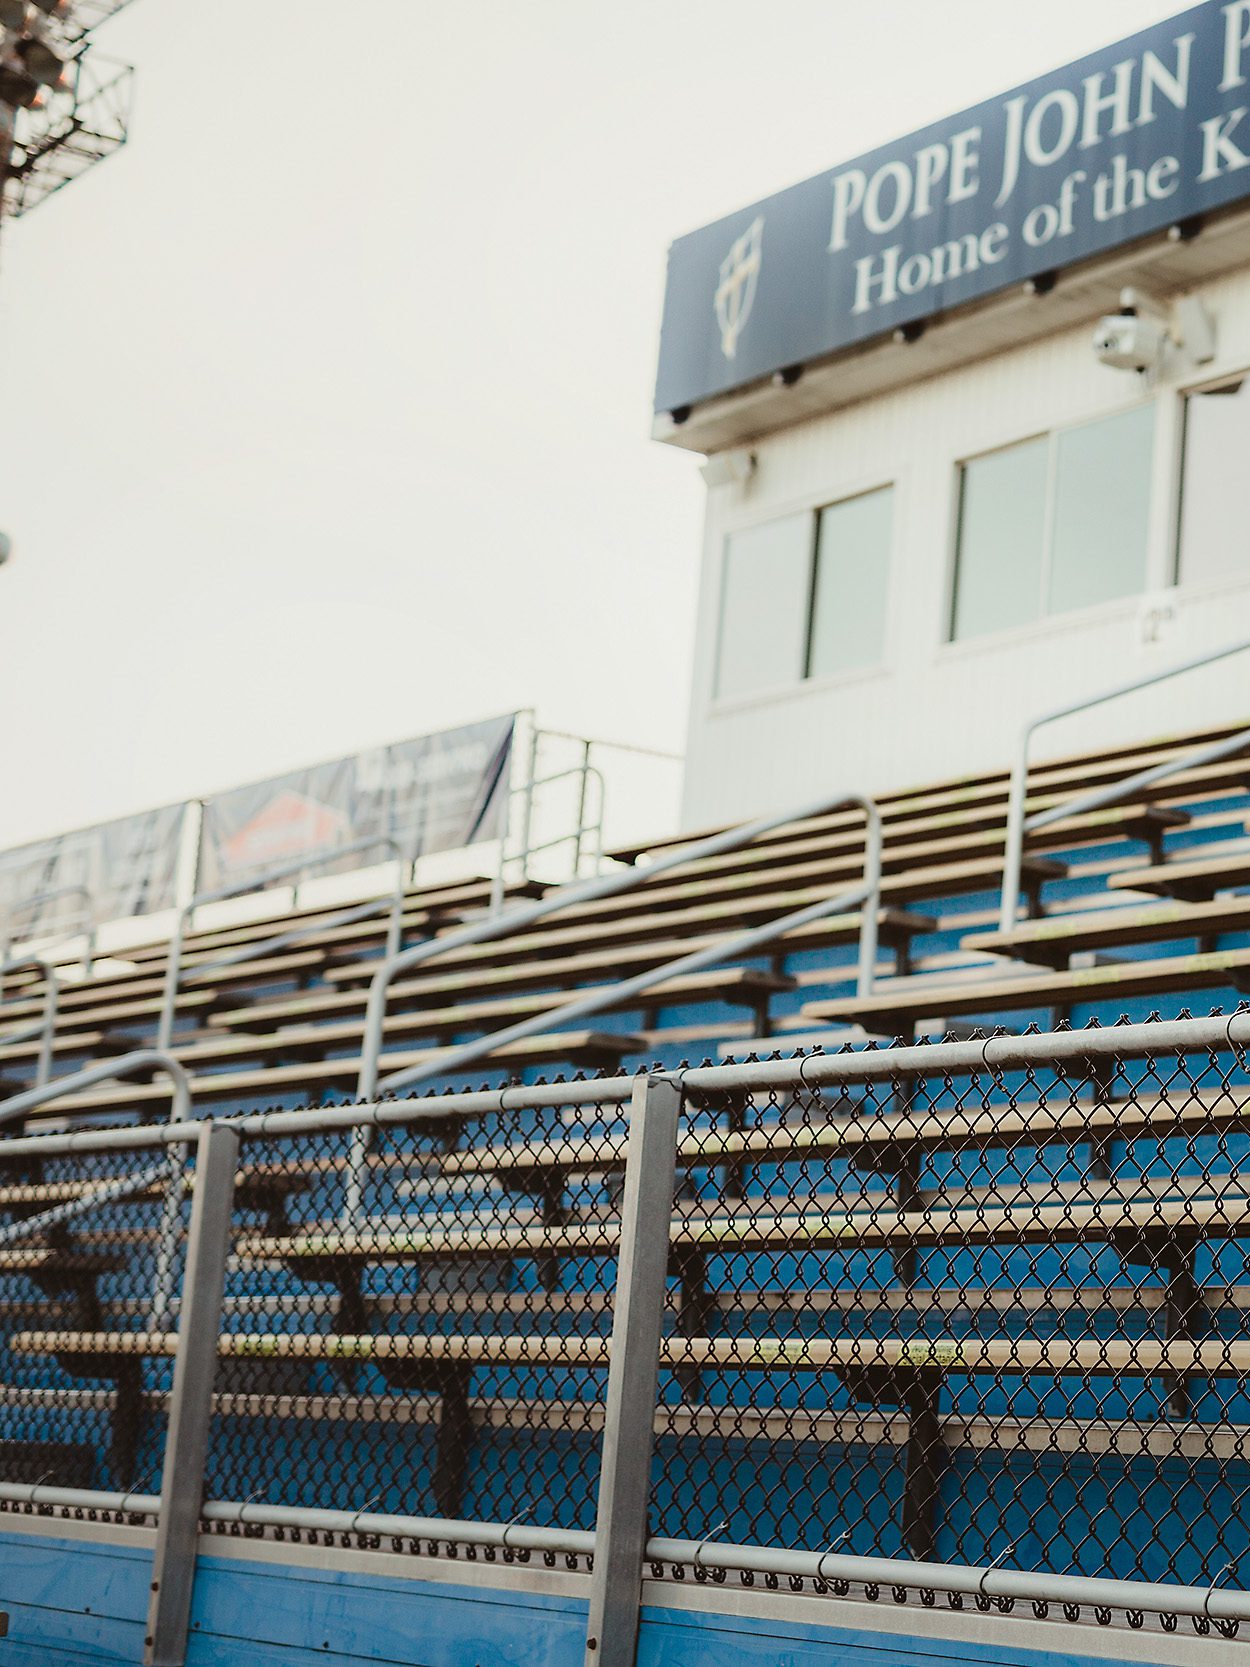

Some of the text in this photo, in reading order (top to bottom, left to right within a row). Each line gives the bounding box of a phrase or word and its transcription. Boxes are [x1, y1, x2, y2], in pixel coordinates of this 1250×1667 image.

[828, 126, 982, 252] POPE
[994, 32, 1196, 209] JOHN
[852, 222, 1009, 315] Home
[1022, 169, 1087, 246] of
[1093, 153, 1180, 222] the
